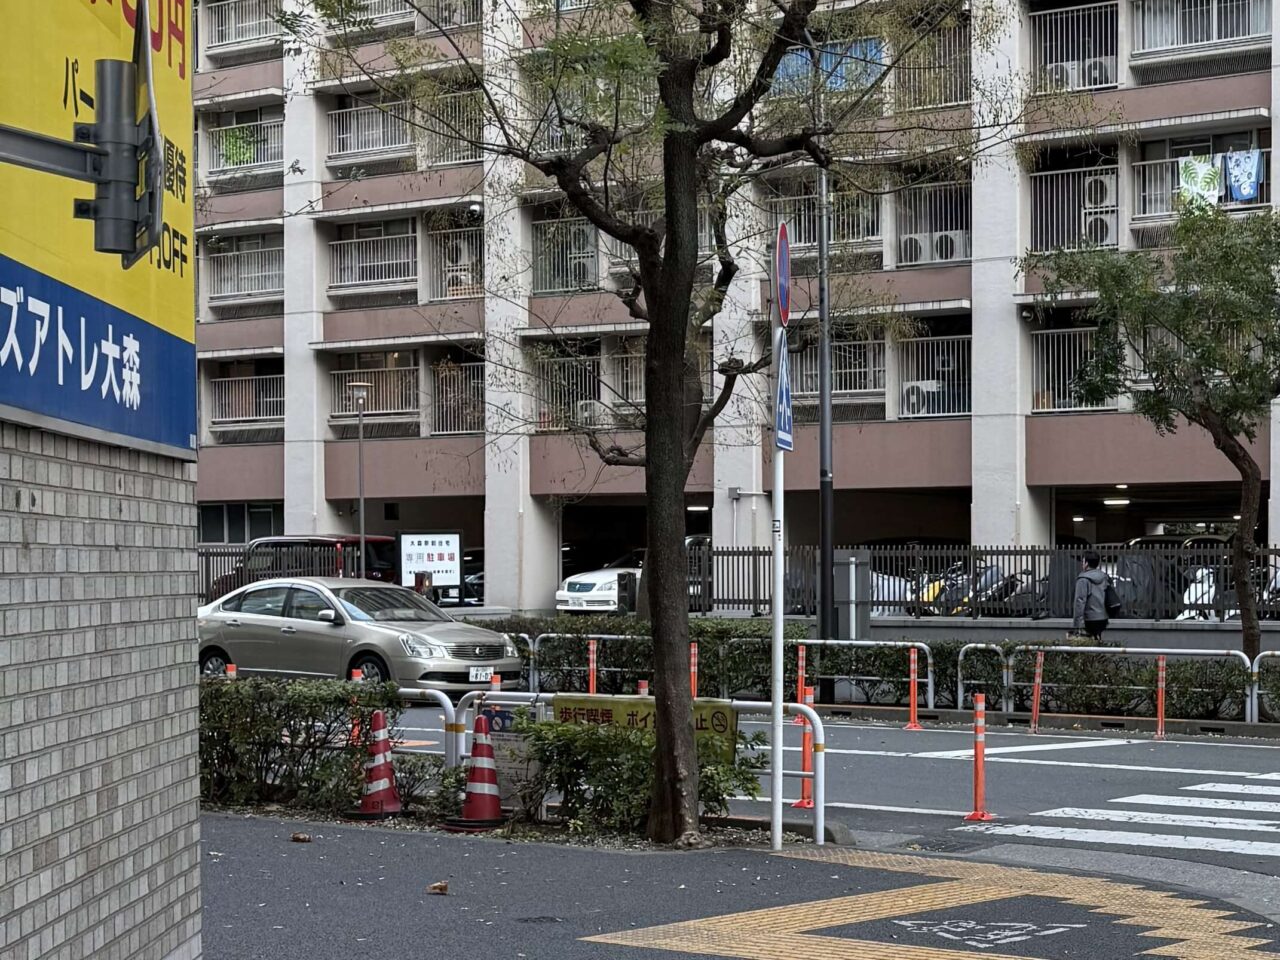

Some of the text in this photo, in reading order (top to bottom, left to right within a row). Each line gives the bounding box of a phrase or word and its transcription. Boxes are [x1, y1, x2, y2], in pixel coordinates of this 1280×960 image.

[0, 286, 141, 410] ズアトレ大森
